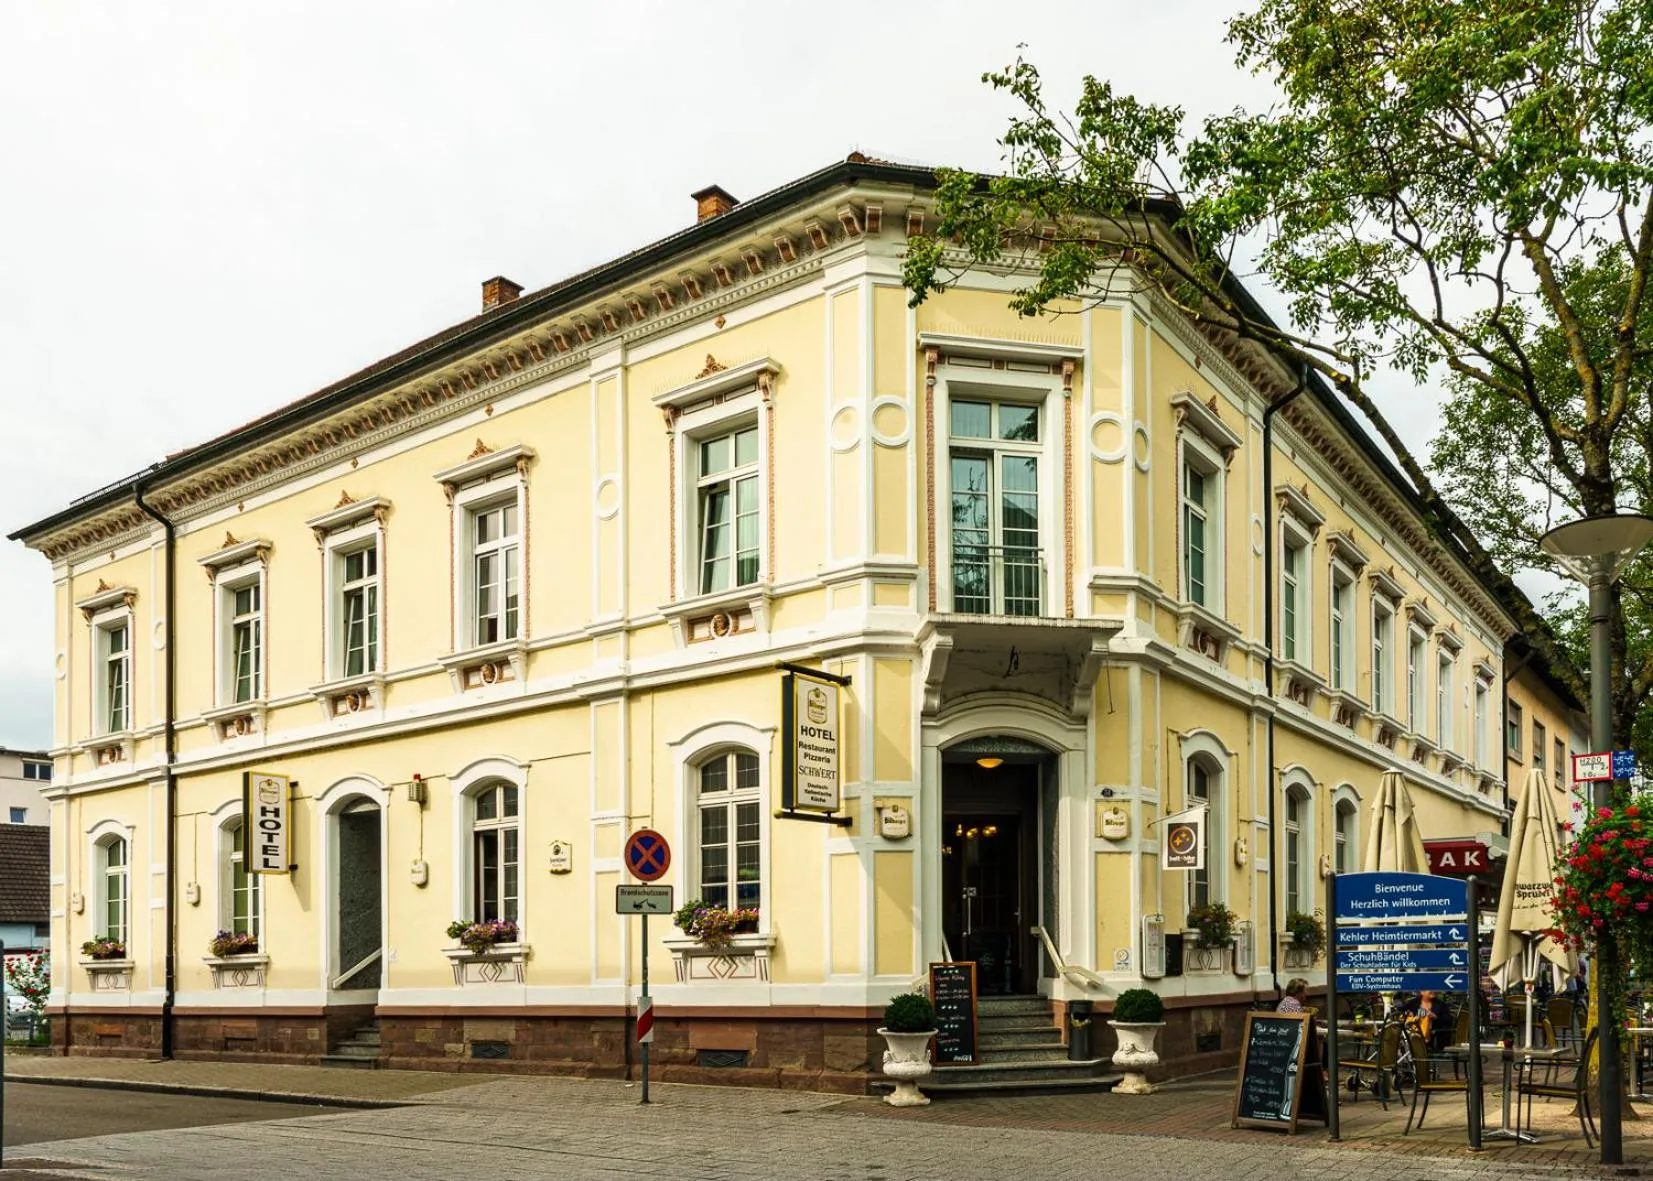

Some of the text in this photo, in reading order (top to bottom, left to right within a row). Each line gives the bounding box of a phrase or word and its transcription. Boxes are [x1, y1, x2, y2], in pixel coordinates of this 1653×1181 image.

[801, 725, 835, 741] HOTEL
[799, 741, 836, 754] Restaurant
[804, 752, 830, 763] Pizzeria
[799, 766, 836, 779] SCHWERT
[259, 806, 281, 868] HOTEL
[1375, 883, 1425, 894] Bienvenue
[1350, 897, 1451, 910] Herzlich willkommen
[1340, 930, 1442, 943] Kehler Heimtiermarkt
[1348, 952, 1409, 962] SchuhBändel
[1349, 975, 1404, 985] Fun Computer
